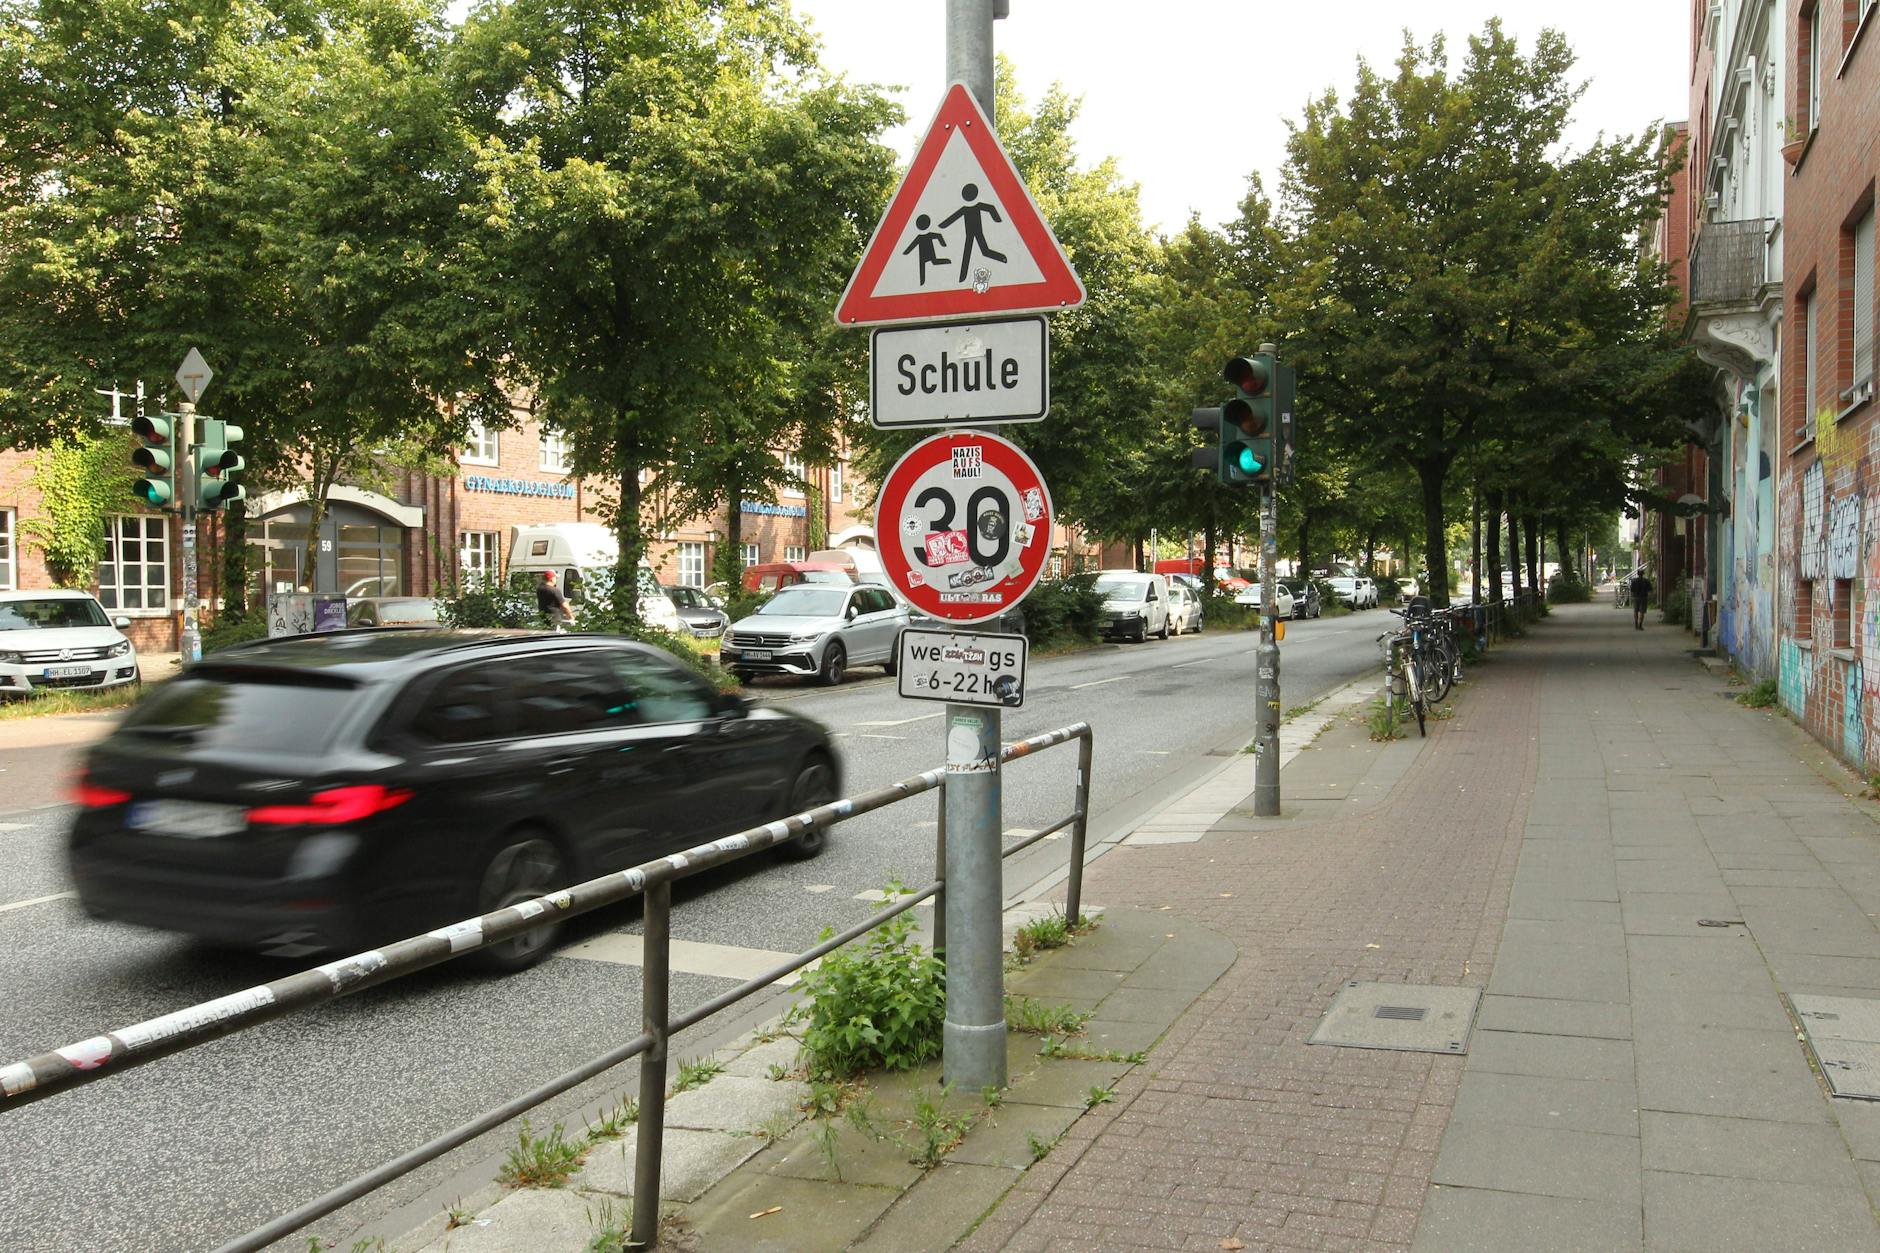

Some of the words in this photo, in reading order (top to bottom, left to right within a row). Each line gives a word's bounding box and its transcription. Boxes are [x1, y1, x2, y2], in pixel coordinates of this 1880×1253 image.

[897, 348, 1019, 396] Schule
[953, 447, 981, 457] NAZIS
[953, 458, 981, 467] AUFS
[953, 467, 981, 478] MAUL!
[914, 486, 1010, 568] 30
[321, 540, 332, 551] 59
